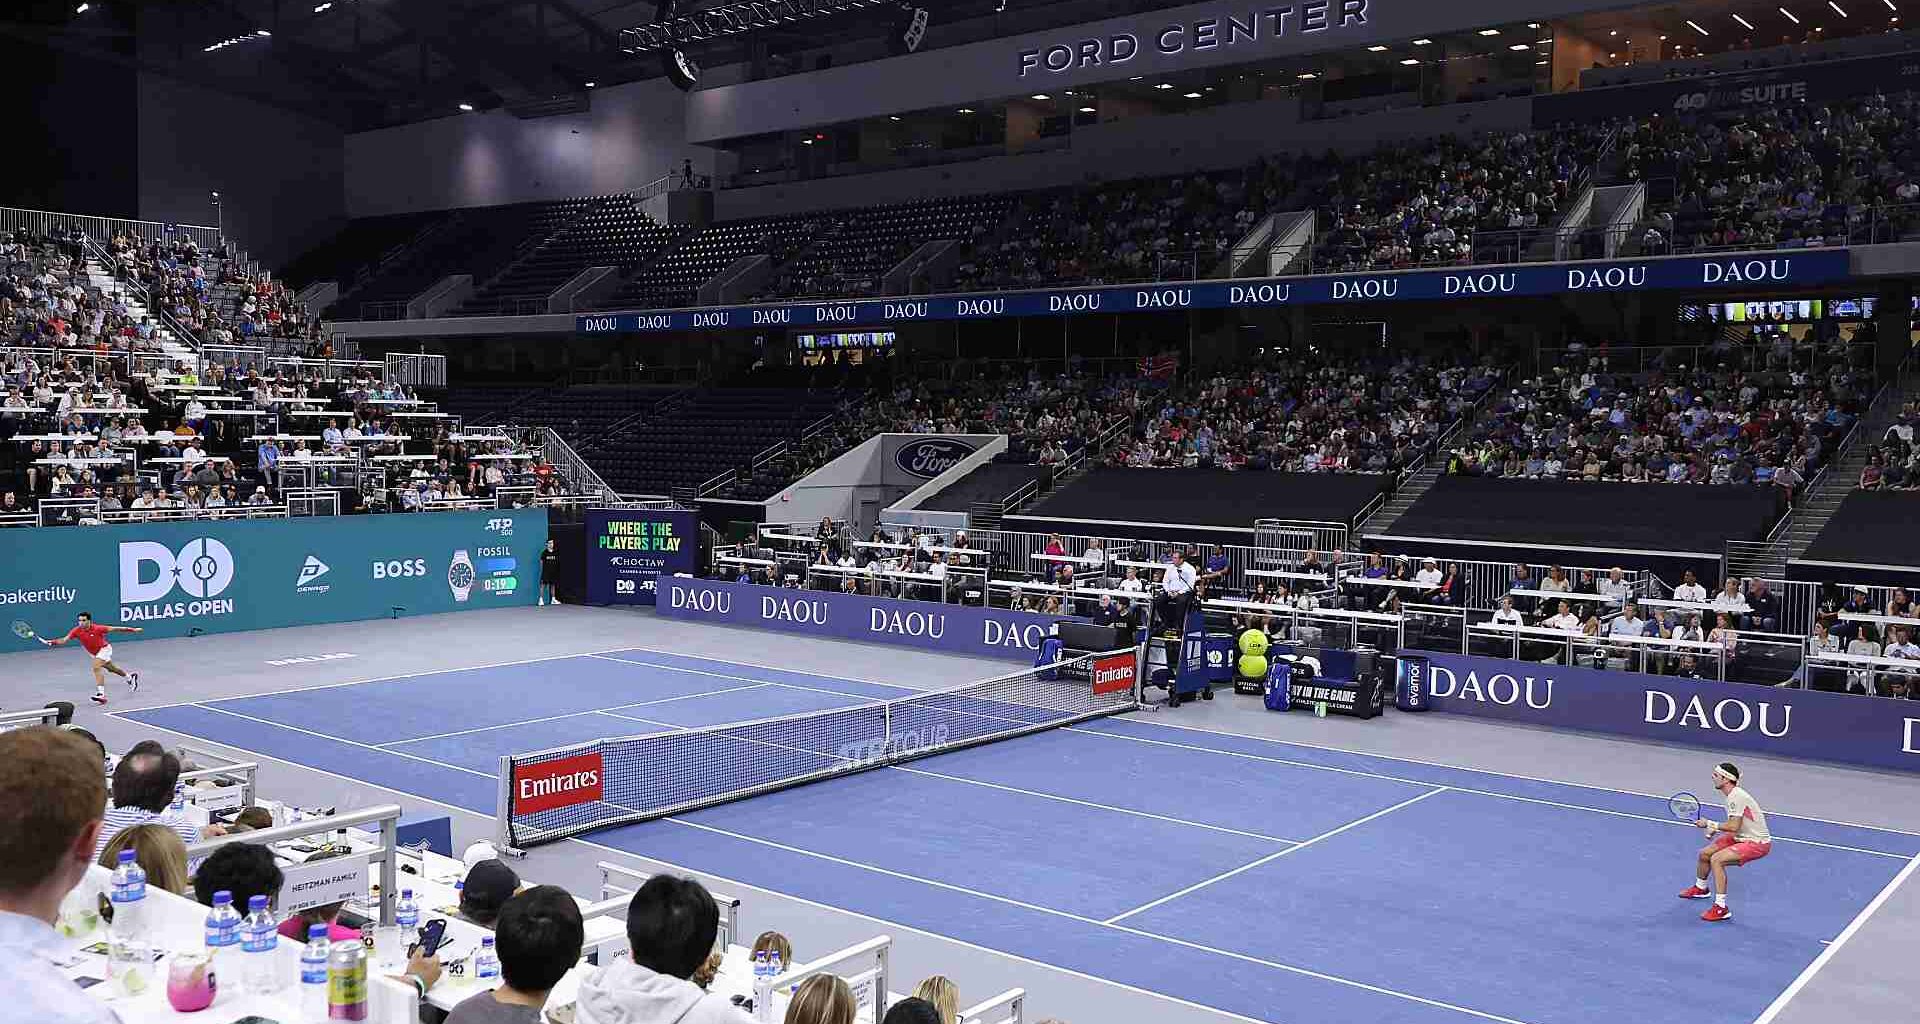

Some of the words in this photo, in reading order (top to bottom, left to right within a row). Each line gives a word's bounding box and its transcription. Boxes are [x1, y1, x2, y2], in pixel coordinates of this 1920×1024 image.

[1019, 33, 1138, 77] FORD
[1154, 0, 1368, 54] CENTER
[1567, 266, 1647, 290] DAOU
[1703, 259, 1791, 284] DAOU
[1230, 284, 1290, 304] DAOU
[1332, 279, 1398, 300] DAOU
[1444, 273, 1516, 295] DAOU
[958, 299, 1004, 316] DAOU
[1050, 294, 1100, 312] DAOU
[1136, 289, 1191, 308] DAOU
[693, 312, 729, 328] DAOU
[752, 310, 791, 325] DAOU
[816, 306, 857, 322] DAOU
[884, 302, 928, 319] DAOU
[585, 318, 617, 333] DAOU
[637, 315, 671, 330] DAOU
[607, 521, 648, 536] WHERE
[651, 522, 673, 537] THE
[477, 546, 511, 558] FOSSIL
[599, 535, 649, 551] PLAYERS
[652, 537, 681, 552] PLAY
[373, 558, 427, 580] BOSS
[120, 601, 185, 623] DALLAS
[188, 598, 233, 617] OPEN
[671, 586, 731, 614] DAOU
[762, 596, 828, 625] DAOU
[870, 607, 945, 639] DAOU
[984, 619, 1052, 650] DAO
[1096, 665, 1134, 685] Emirates
[1409, 661, 1420, 706] evamor
[1313, 687, 1331, 700] THE
[1330, 688, 1357, 703] GAME
[1429, 665, 1554, 710] DAOU
[1643, 690, 1793, 738] DAOU
[891, 724, 949, 757] TOUR
[519, 769, 599, 800] Emirates
[291, 877, 331, 893] HEITZMAN
[331, 871, 358, 884] FAMILY
